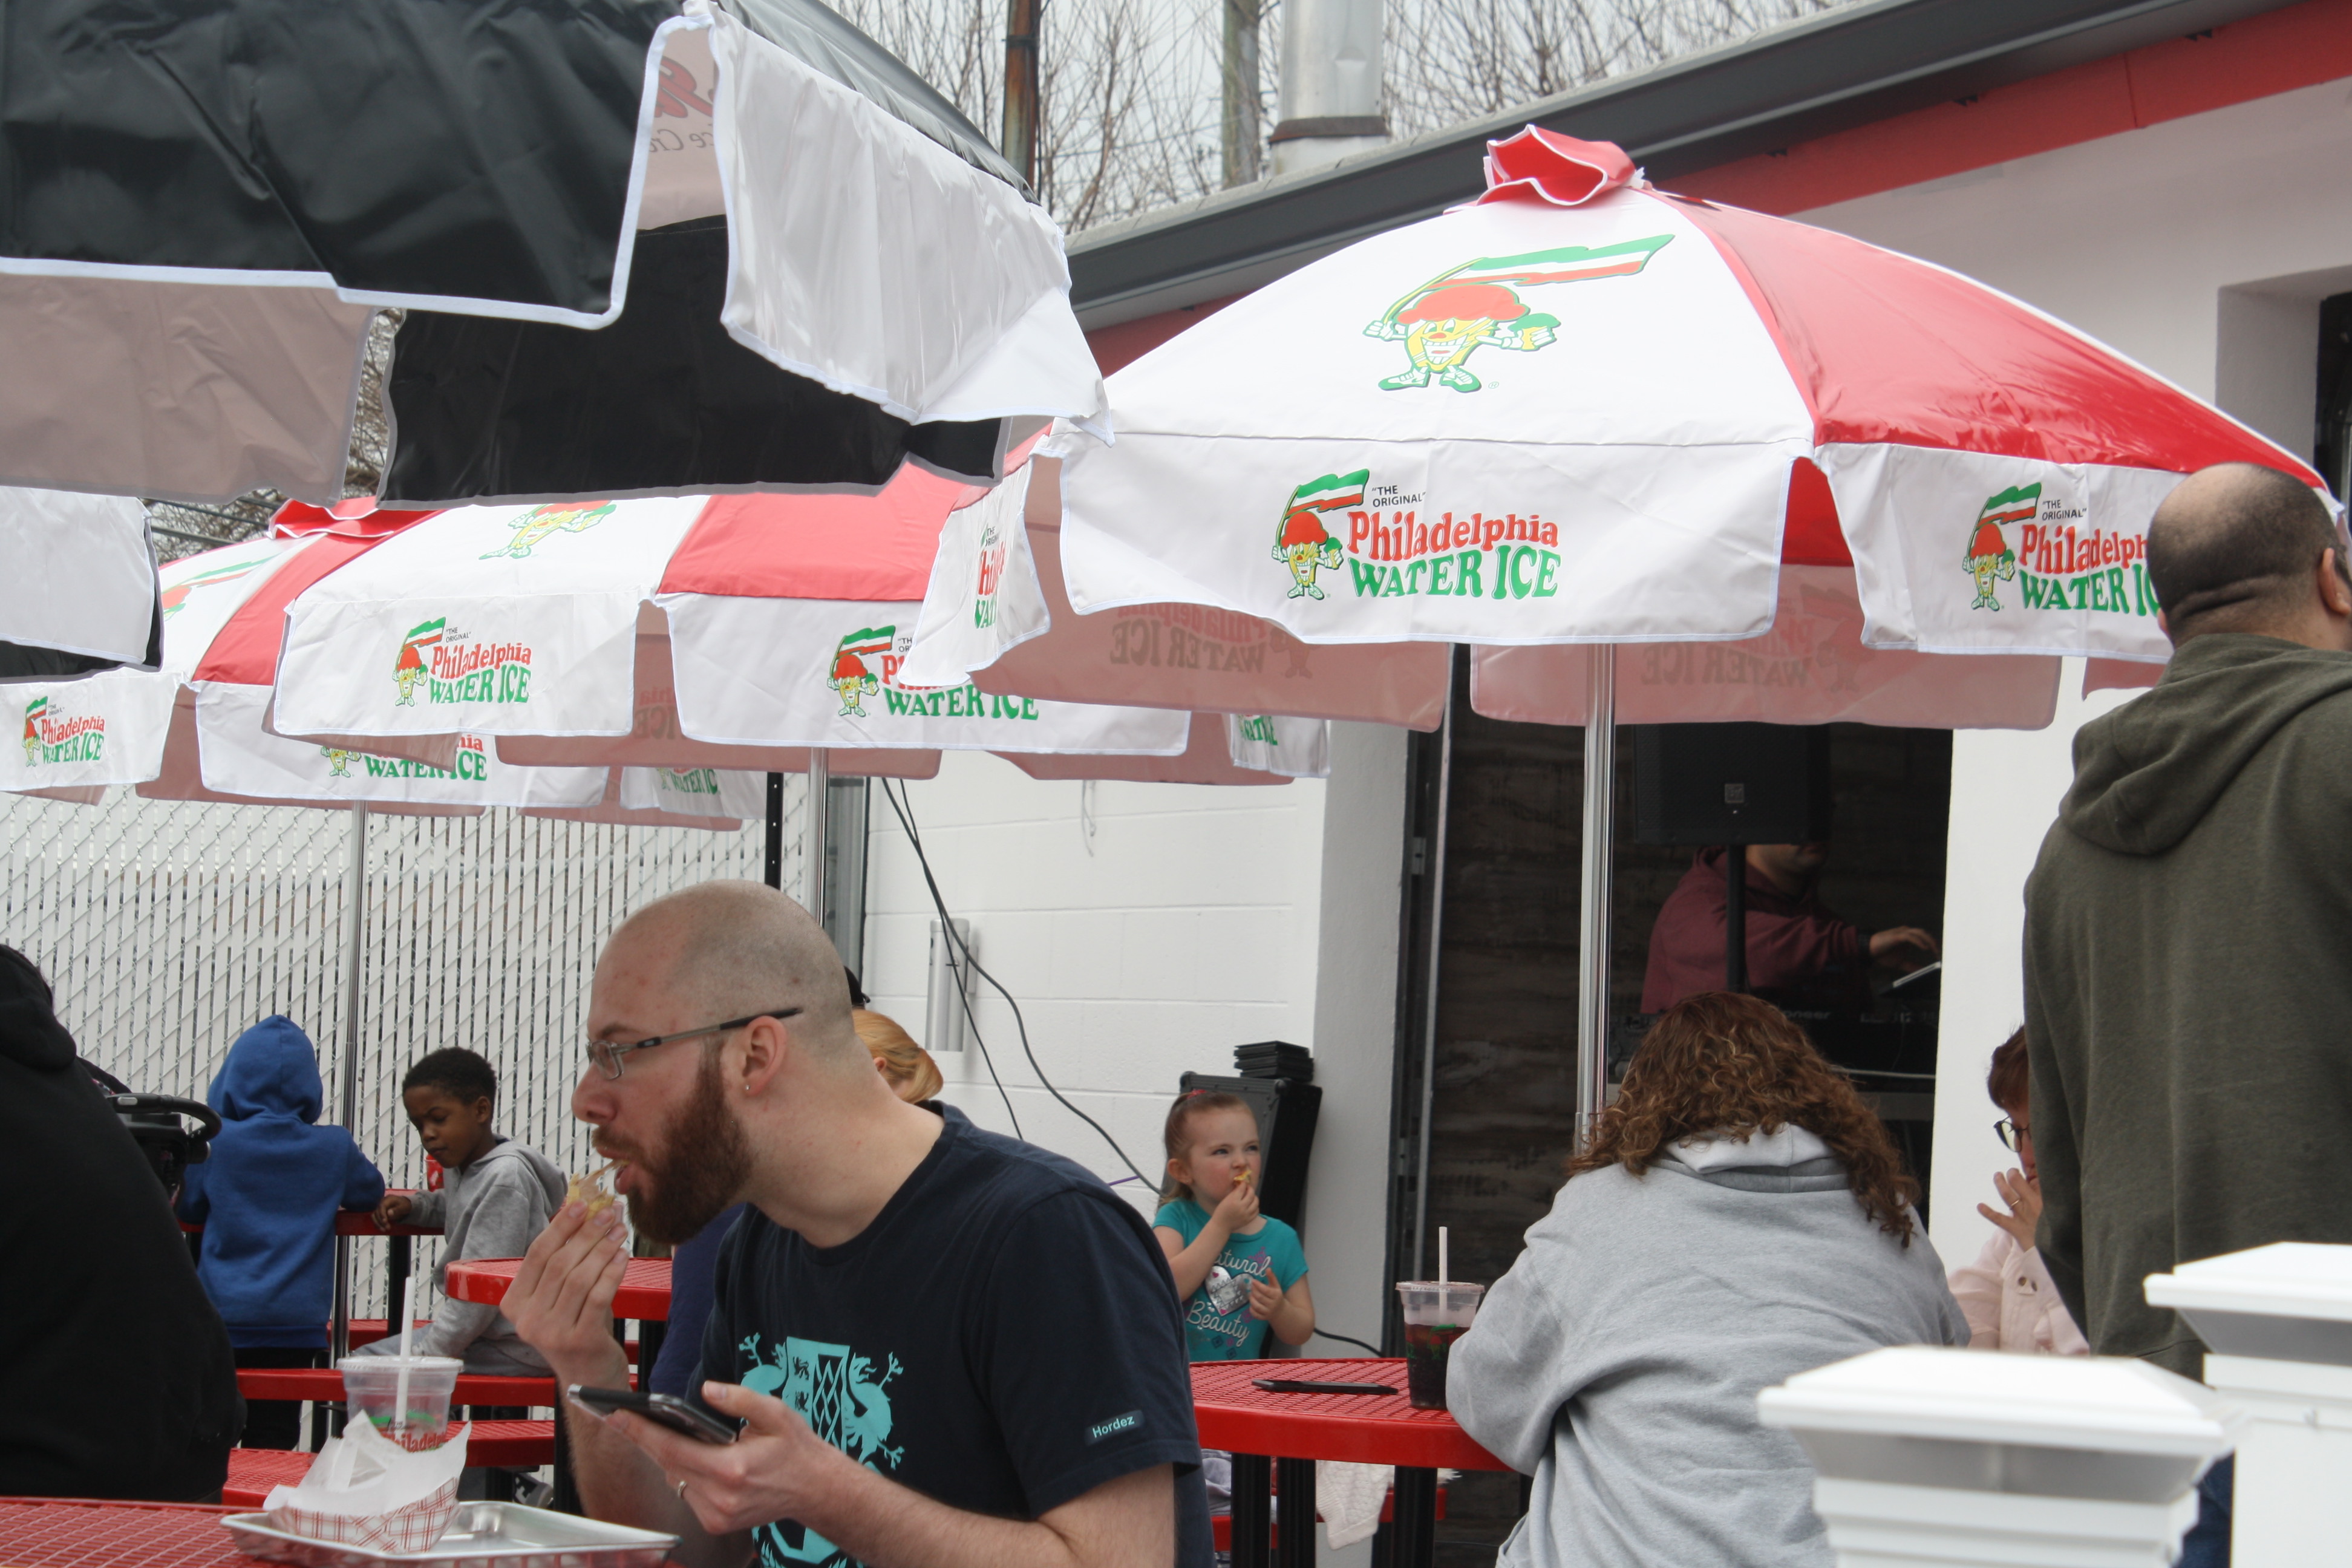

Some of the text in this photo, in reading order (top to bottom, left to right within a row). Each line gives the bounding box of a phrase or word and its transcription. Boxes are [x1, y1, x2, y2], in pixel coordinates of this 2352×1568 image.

[1372, 492, 1426, 508] ORIGINAL"
[2042, 508, 2087, 521] ORIGINAL"
[1347, 511, 1559, 562] Philadelphia
[2018, 523, 2148, 575] Philadelph
[1348, 544, 1562, 600] WATER ICE
[2018, 566, 2130, 615] WATER
[430, 642, 532, 679] Philadelphia
[429, 664, 532, 704] WATER ICE
[883, 684, 985, 717] WATER
[42, 731, 105, 764] WATER ICE
[1186, 1299, 1250, 1347] Beauty
[1092, 1416, 1135, 1439] Hordez
